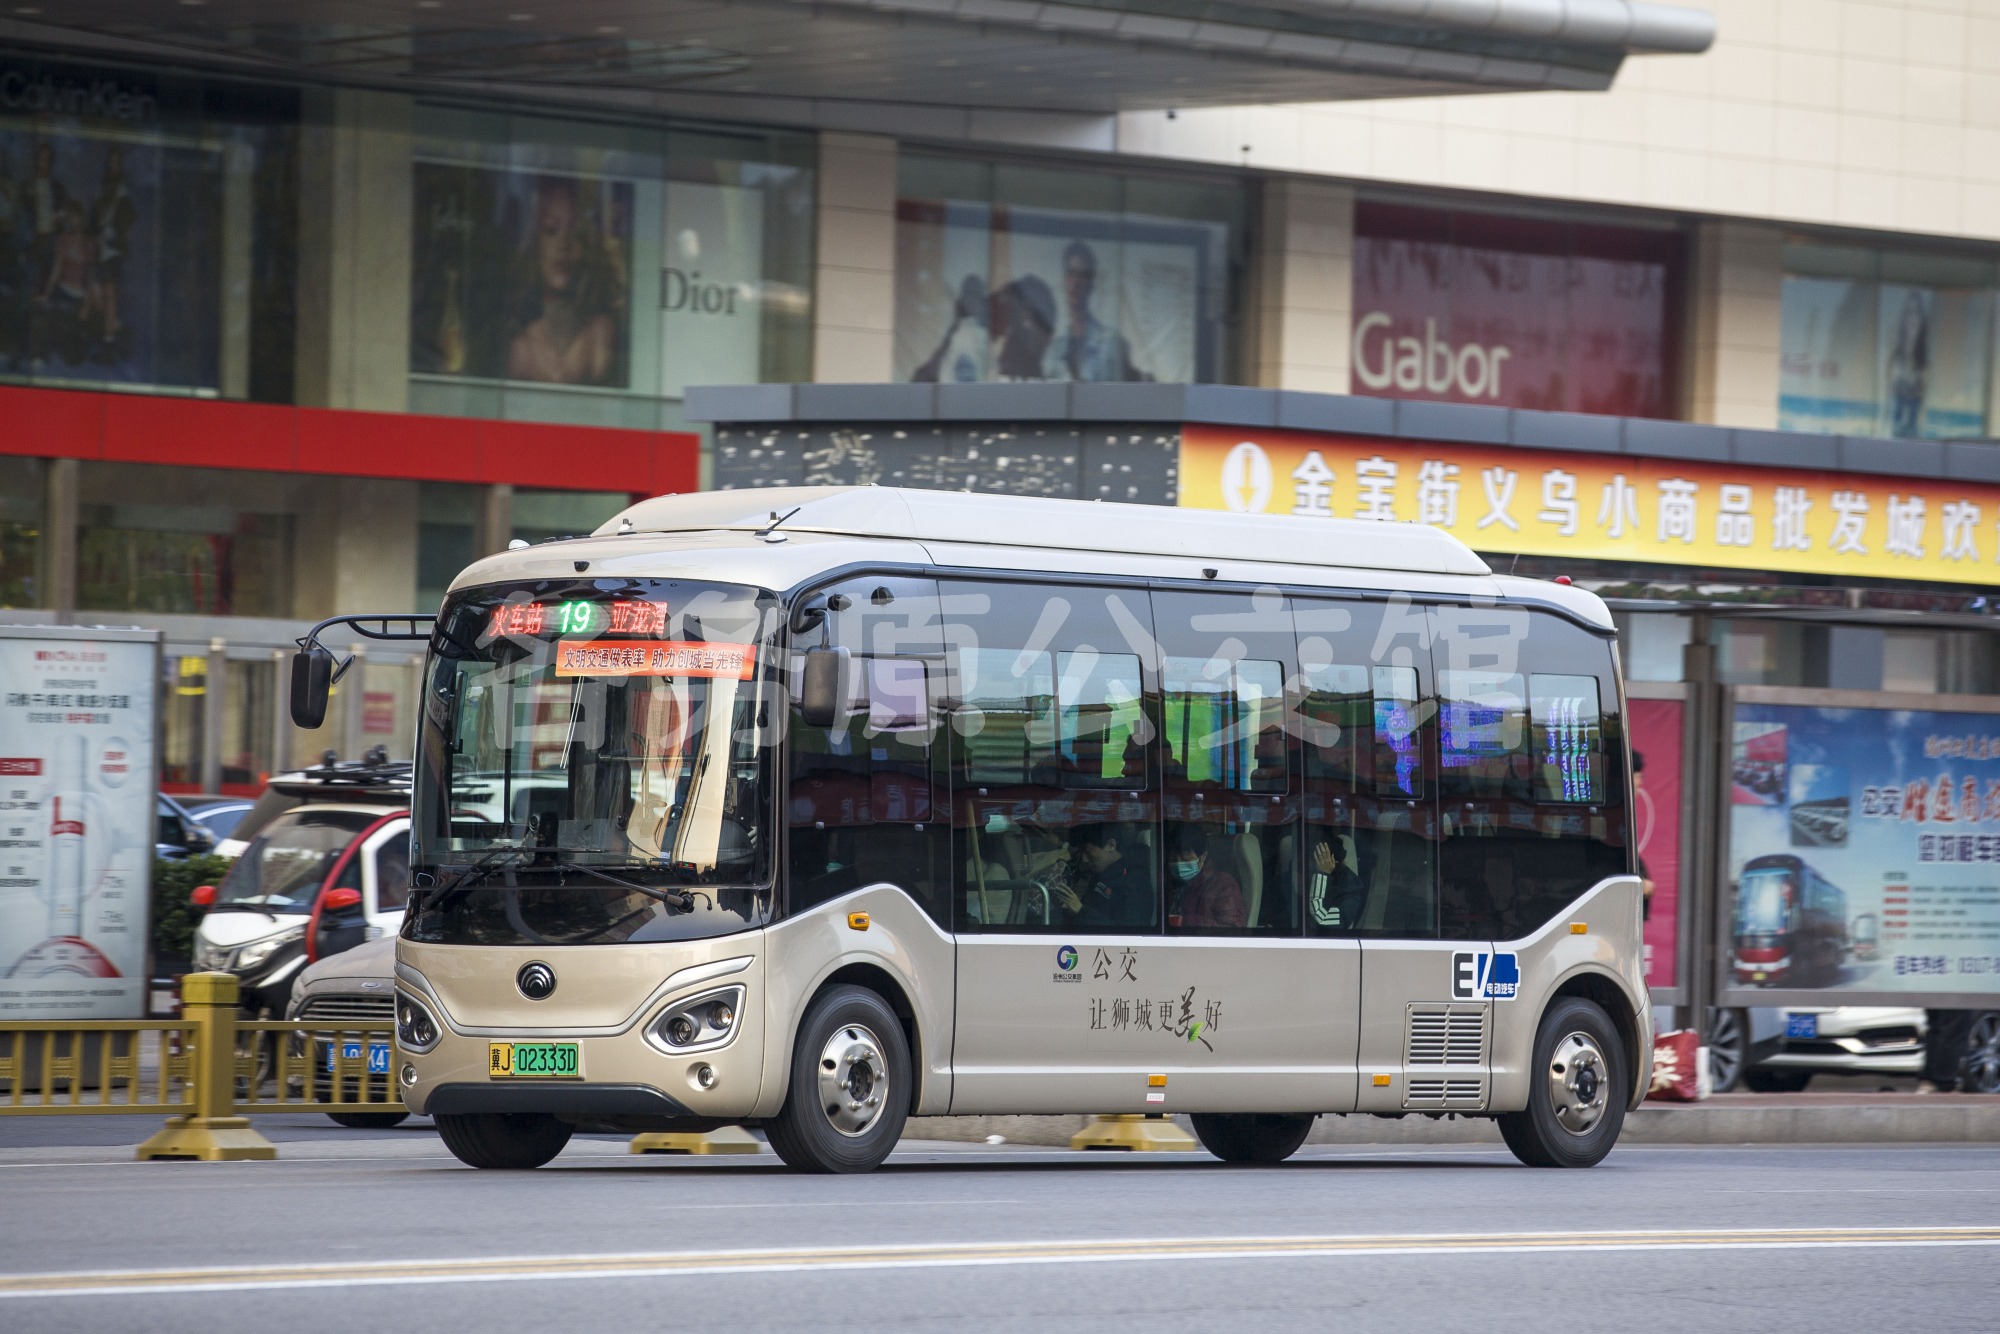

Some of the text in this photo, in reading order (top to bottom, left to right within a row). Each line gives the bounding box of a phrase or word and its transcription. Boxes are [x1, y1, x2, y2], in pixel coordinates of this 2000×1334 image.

[658, 267, 738, 314] Dior
[1353, 311, 1511, 398] Gabor
[489, 601, 667, 637] 火车站 19 亚龙湾
[564, 648, 743, 670] 文明交通做表率 助力创城当先锋
[1092, 946, 1138, 982] 公交
[1486, 982, 1515, 995] 电动汽车
[1089, 986, 1222, 1052] 让狮城更美好
